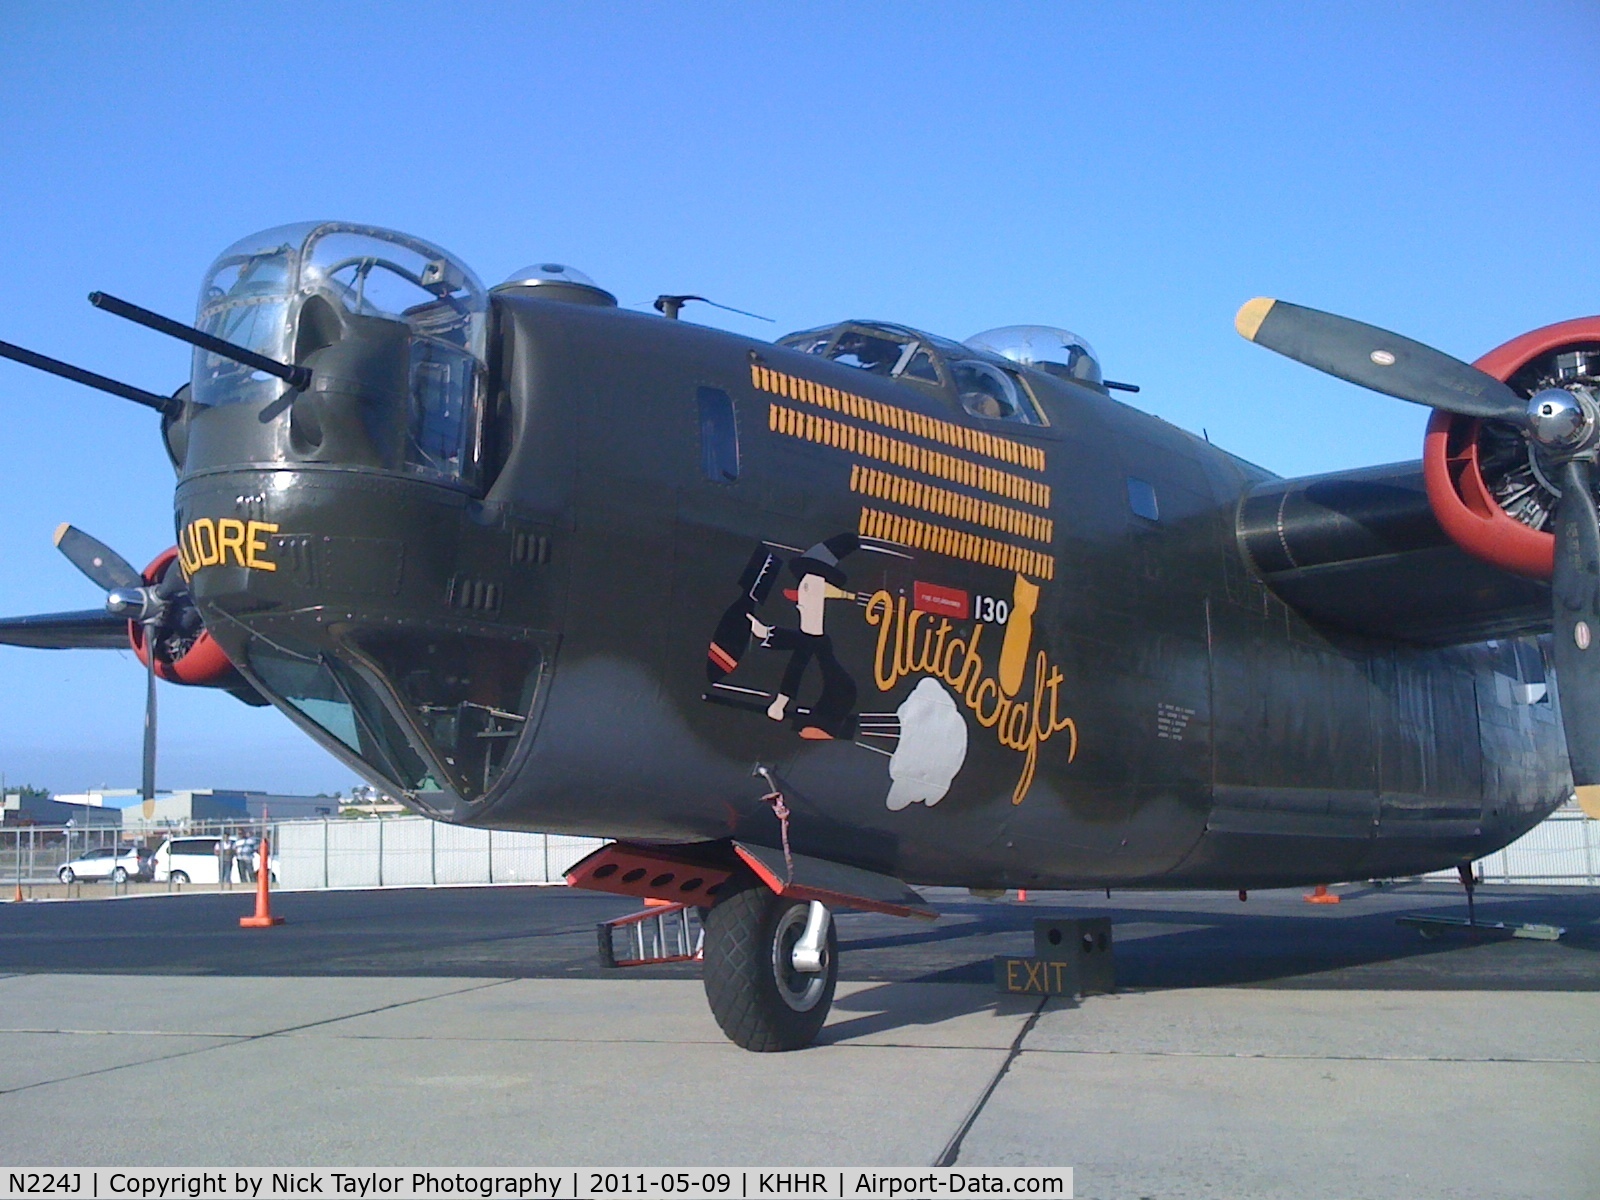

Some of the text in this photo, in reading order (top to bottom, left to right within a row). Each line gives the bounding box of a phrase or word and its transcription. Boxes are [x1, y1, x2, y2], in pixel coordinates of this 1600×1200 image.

[975, 594, 1008, 625] 130
[866, 589, 1078, 806] Witchcraft
[1007, 960, 1068, 993] EXIT
